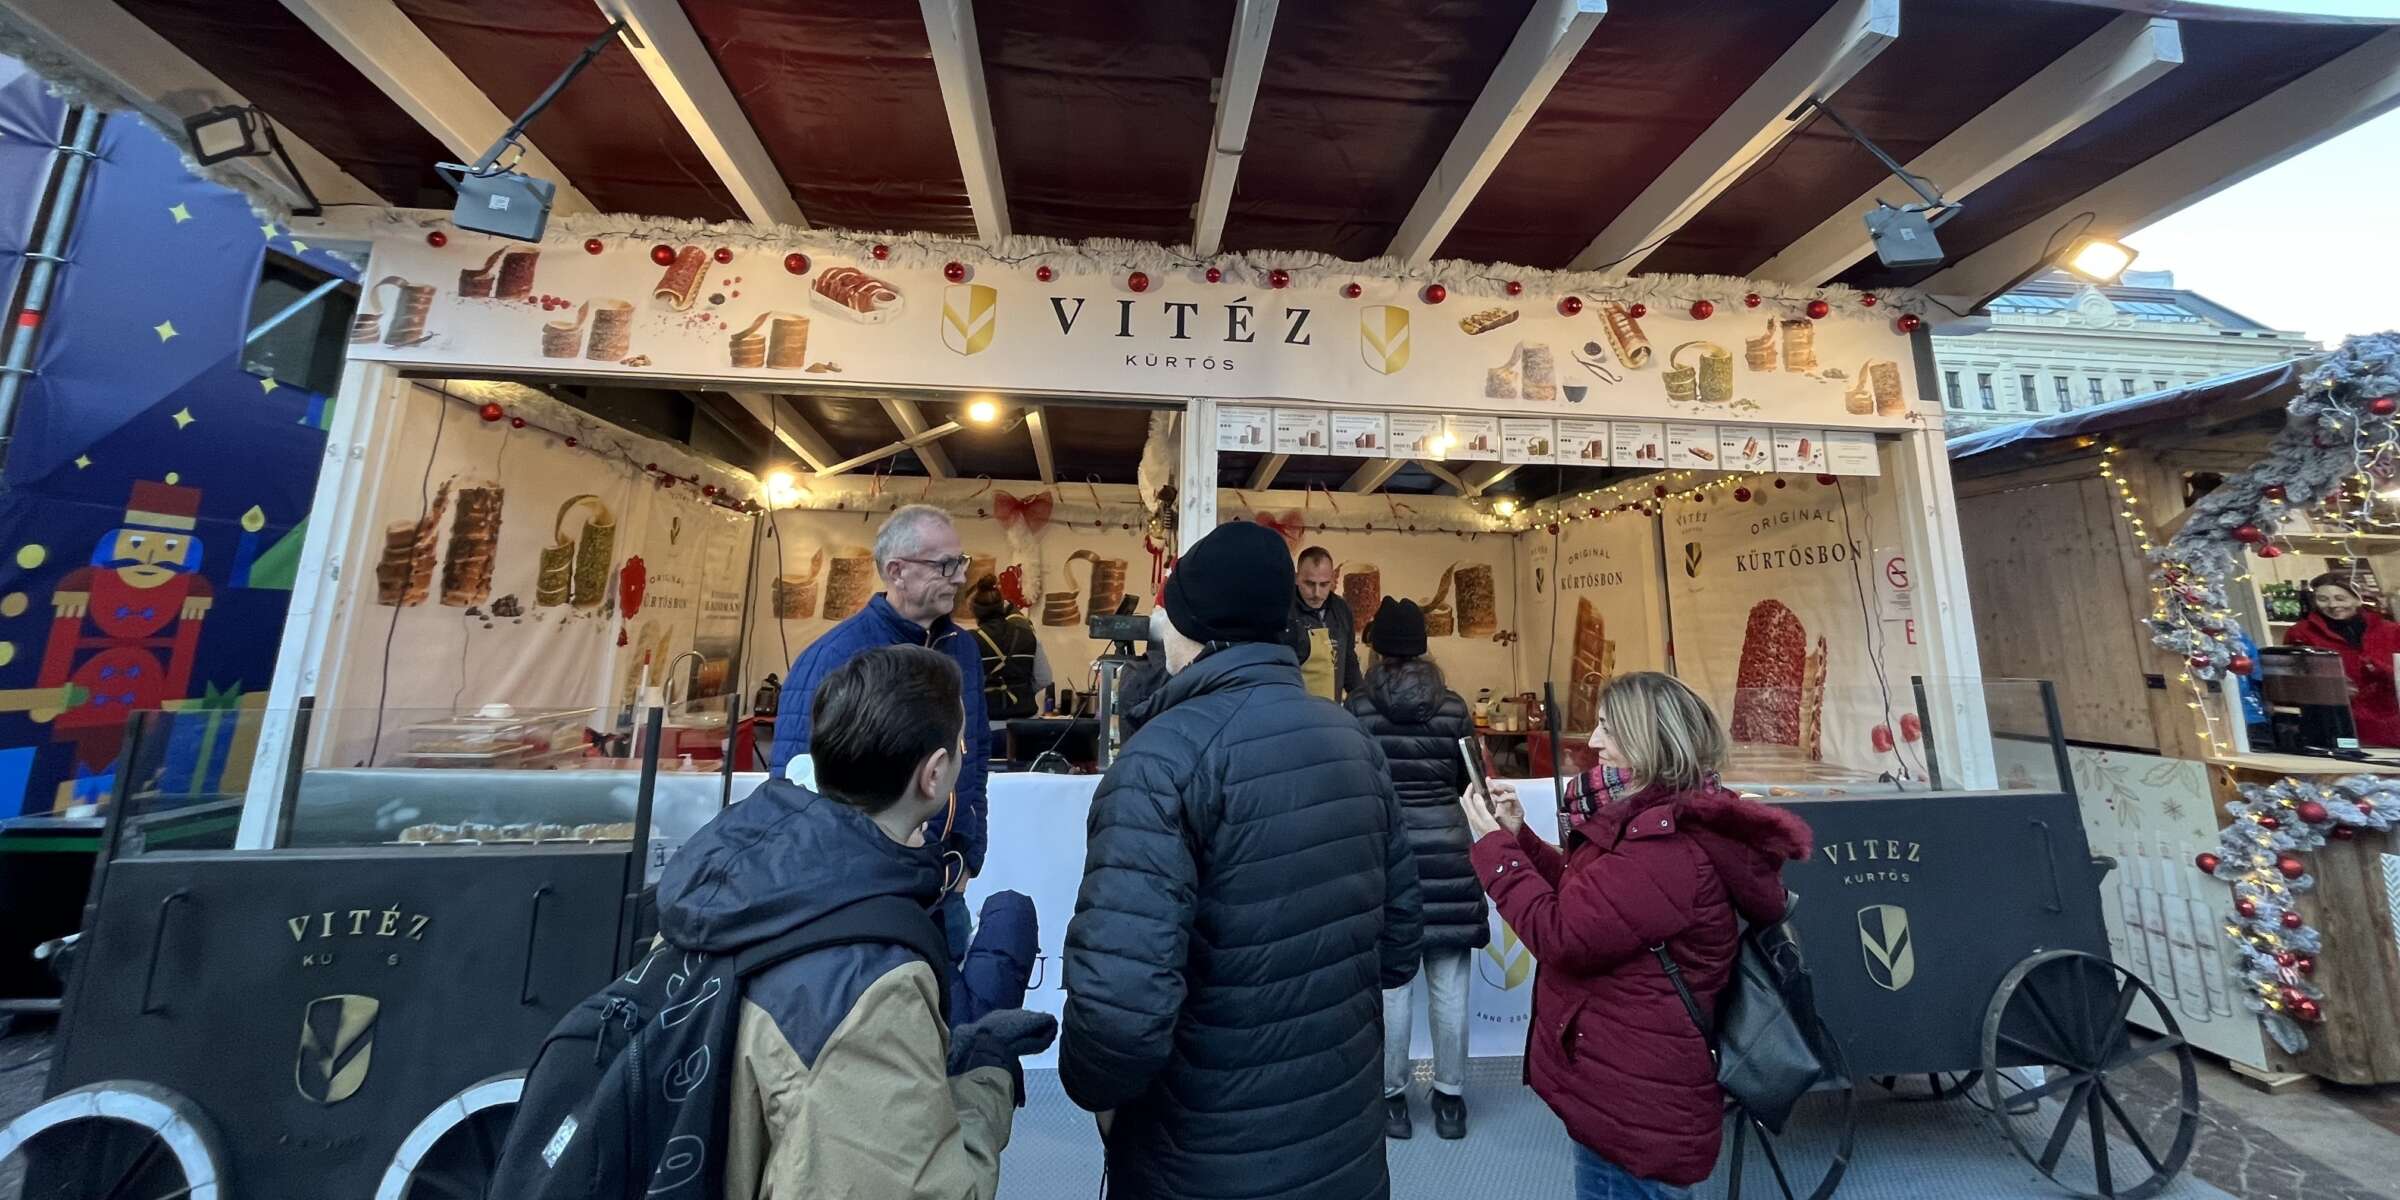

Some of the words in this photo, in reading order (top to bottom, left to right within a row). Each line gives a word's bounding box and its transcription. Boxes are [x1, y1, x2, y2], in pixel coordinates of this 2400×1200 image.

[1050, 296, 1311, 346] VITÉZ
[1751, 508, 1835, 535] ORIGINAL
[1568, 549, 1611, 565] ORIGINAL
[288, 902, 431, 942] VITÉZ
